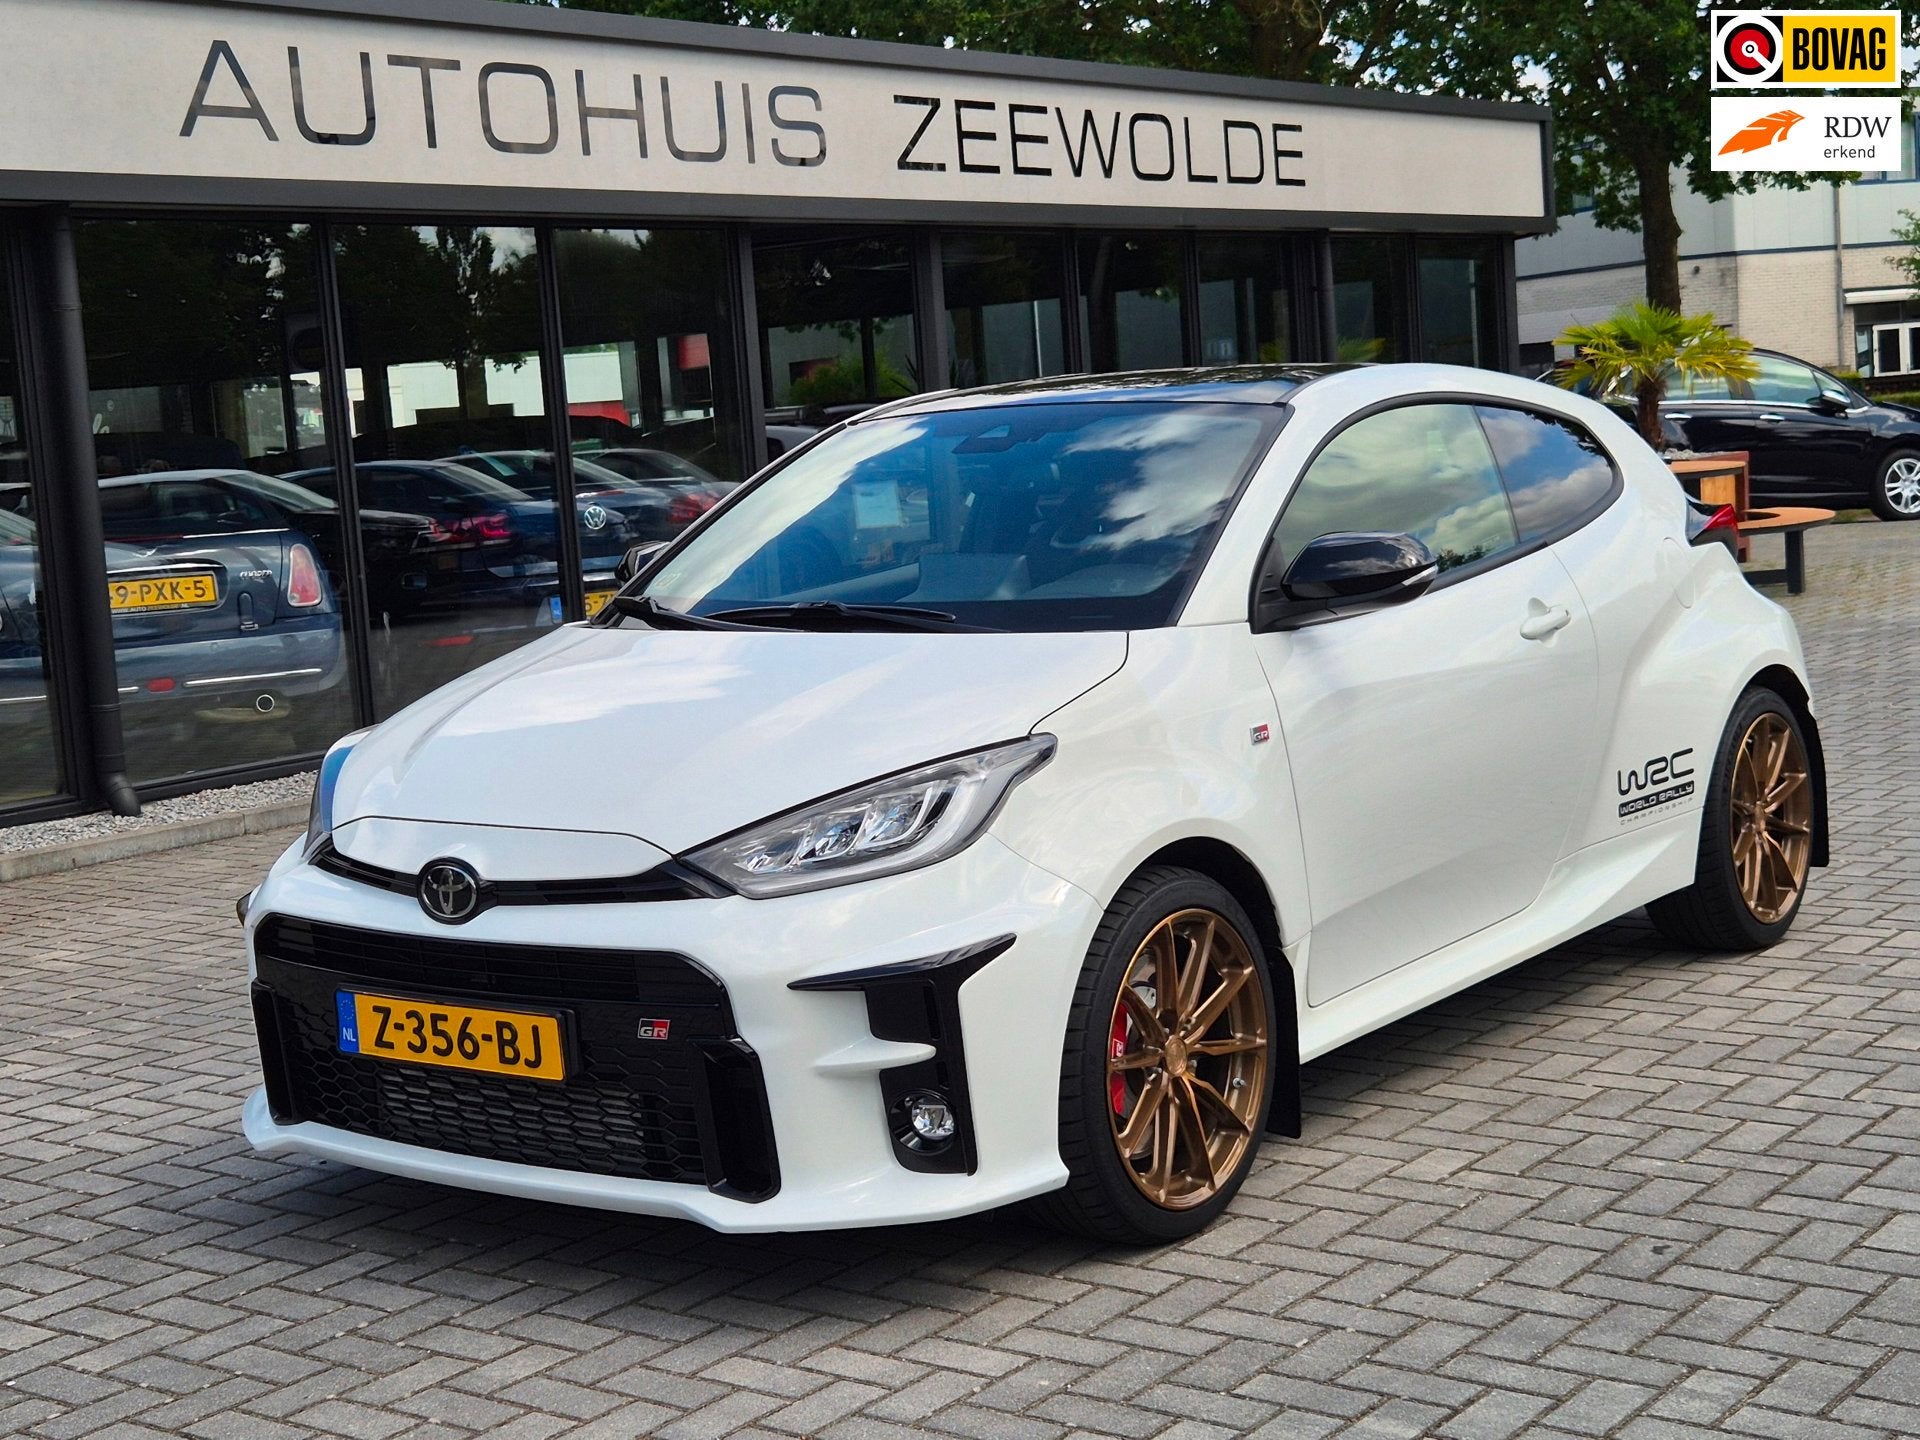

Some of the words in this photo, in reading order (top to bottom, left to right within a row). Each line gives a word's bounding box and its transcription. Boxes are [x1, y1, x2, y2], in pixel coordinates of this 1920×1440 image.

[179, 40, 827, 168] AUTOHUIS
[893, 94, 1306, 187] ZEEWOLDE
[109, 580, 206, 604] 9-PXK-5
[1617, 747, 1694, 796] WRC
[1620, 795, 1657, 815] WORLD
[1658, 783, 1693, 801] RALLY
[342, 1026, 356, 1042] NL
[372, 1004, 543, 1069] Z-356-BJ
